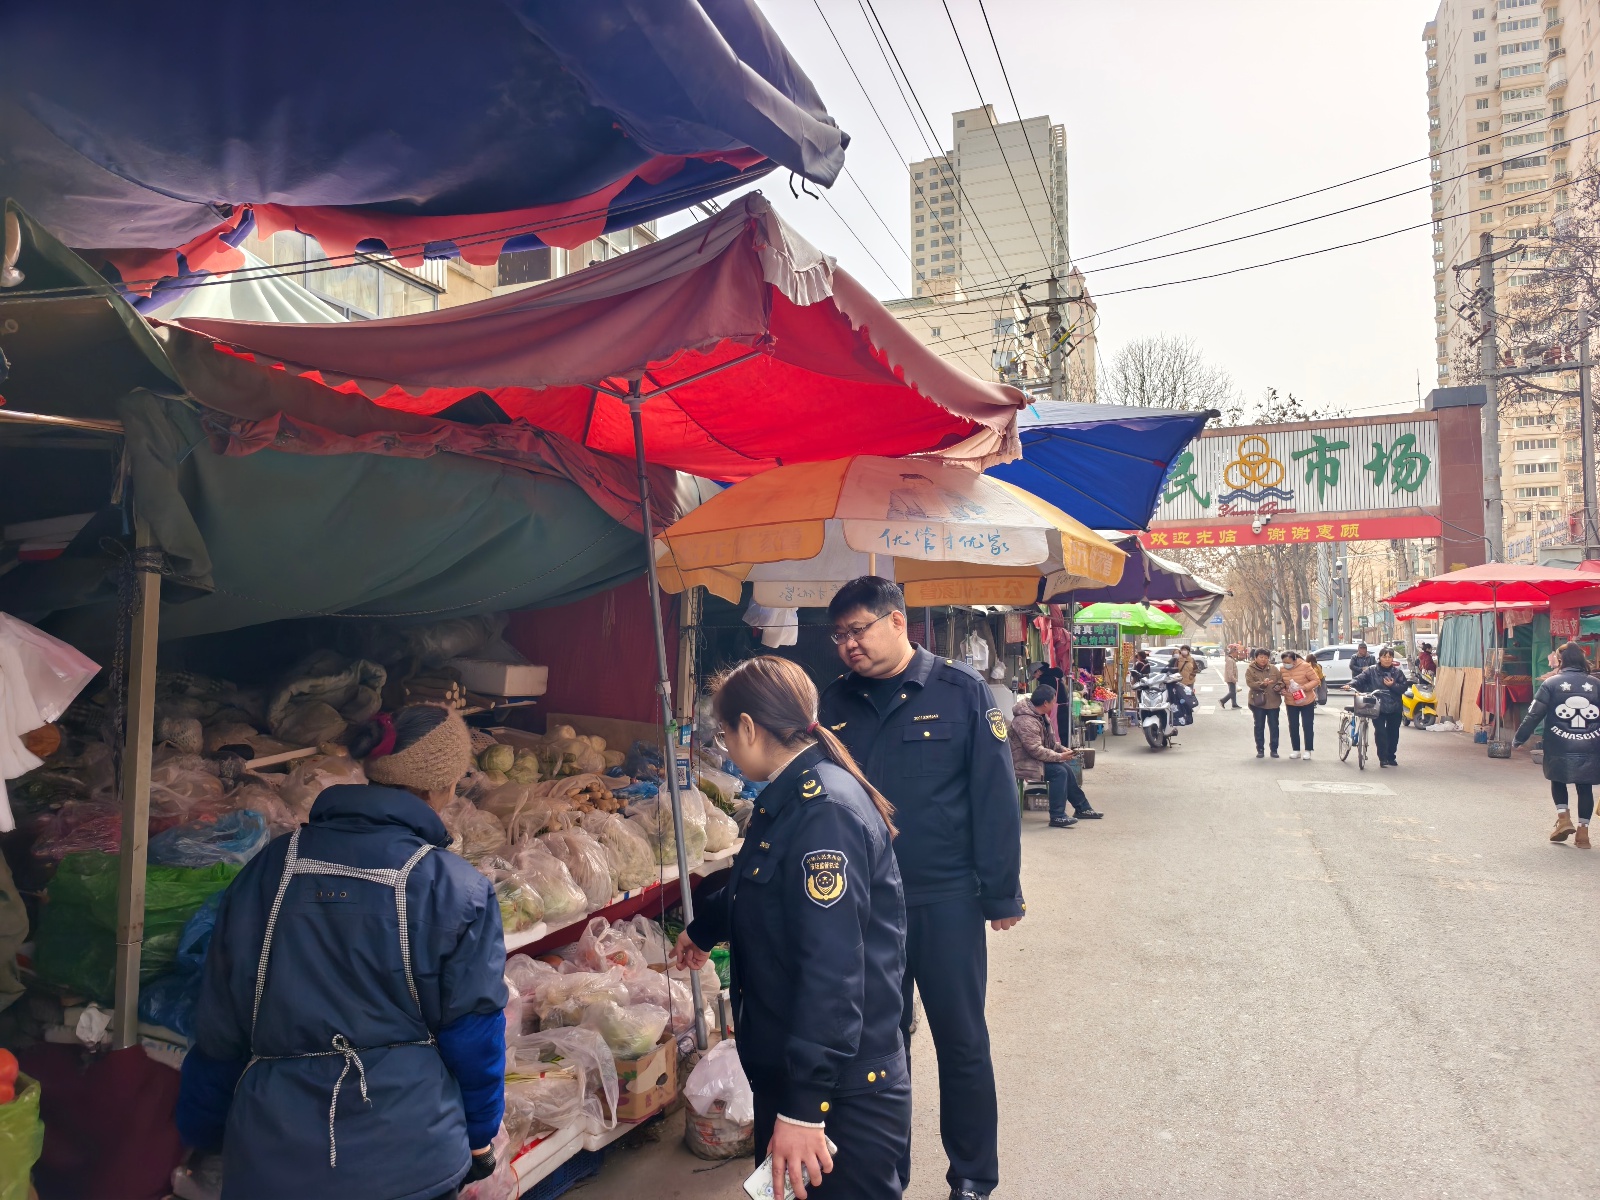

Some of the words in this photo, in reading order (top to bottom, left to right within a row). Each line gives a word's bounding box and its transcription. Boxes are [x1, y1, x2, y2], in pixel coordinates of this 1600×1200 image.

[1164, 451, 1211, 509] 民
[1291, 433, 1432, 506] 市场
[1150, 529, 1238, 547] 欢迎光临
[1267, 523, 1360, 542] 谢谢惠顾
